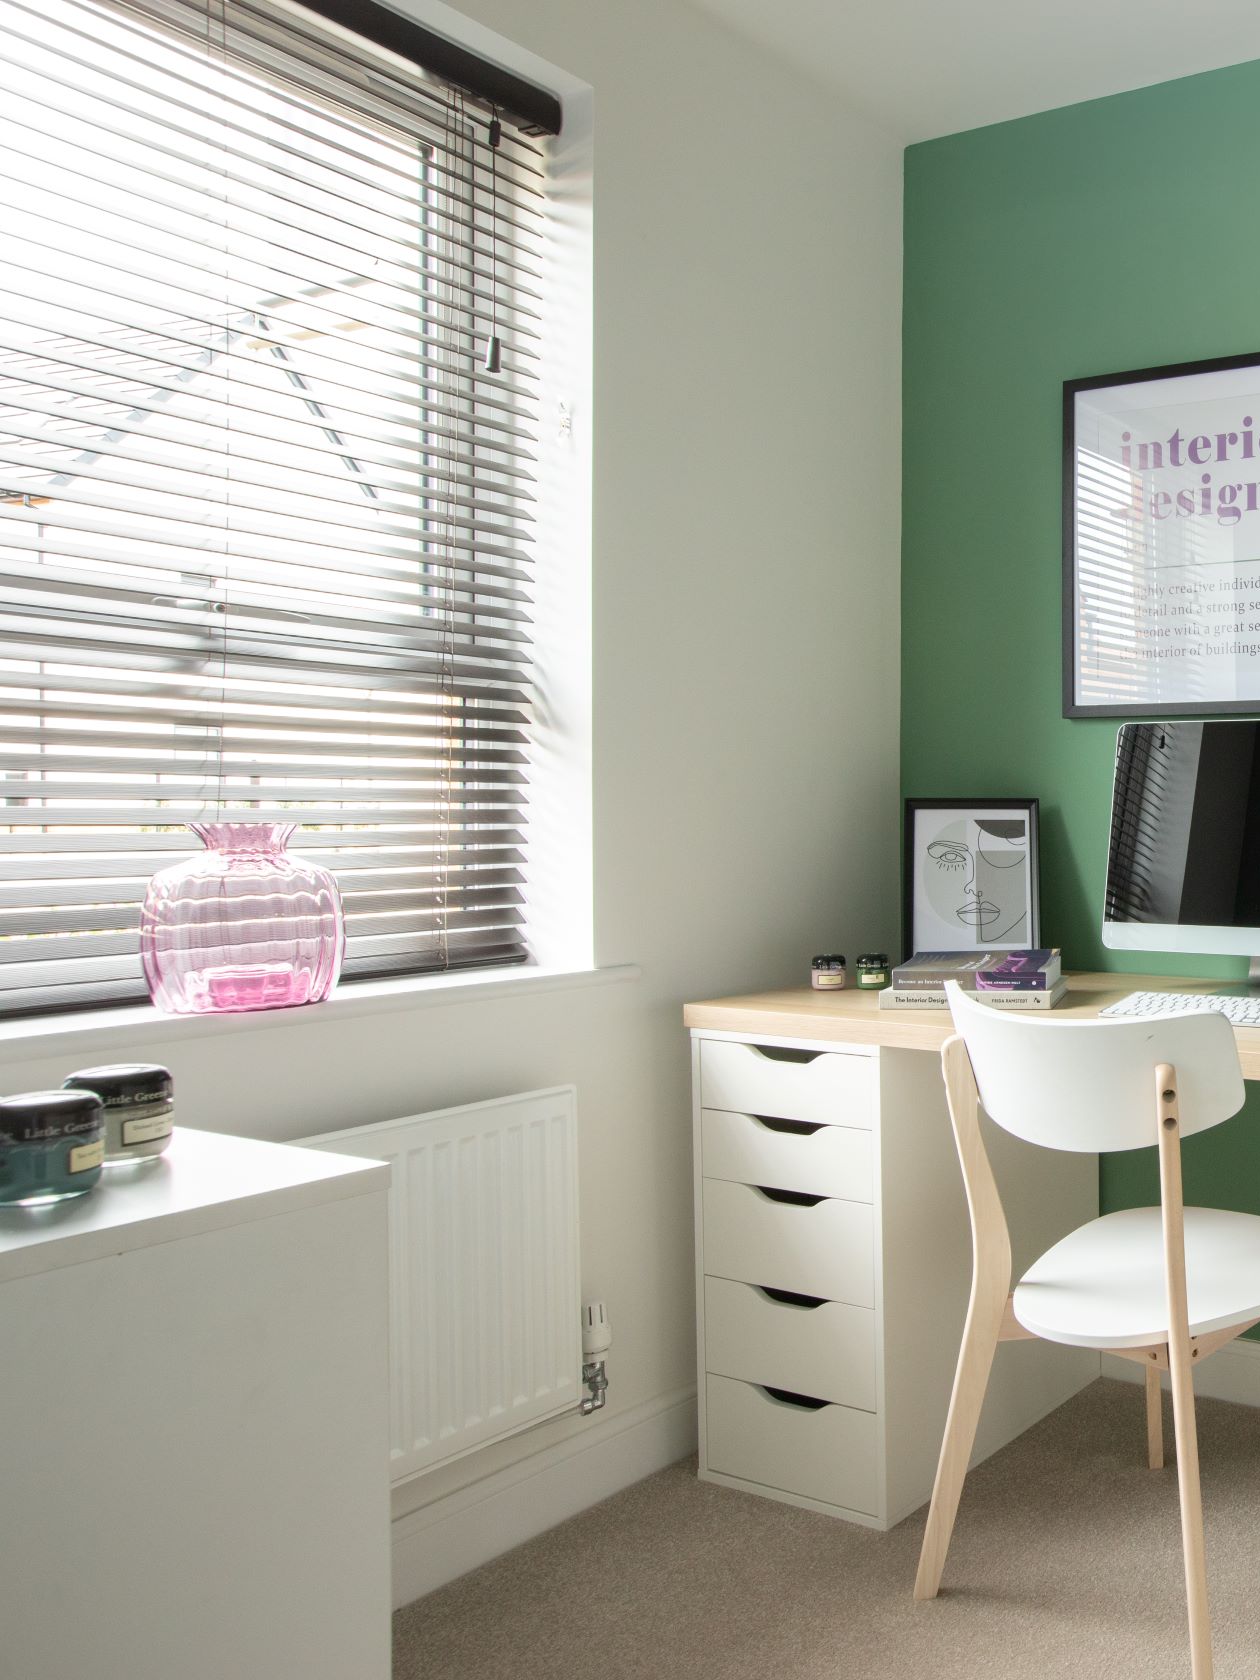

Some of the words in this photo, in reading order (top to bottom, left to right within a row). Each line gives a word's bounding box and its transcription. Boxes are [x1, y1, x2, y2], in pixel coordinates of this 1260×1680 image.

[1169, 581, 1215, 596] creative
[1170, 601, 1193, 617] and
[1206, 601, 1246, 615] strong
[1174, 622, 1200, 637] with
[1214, 621, 1245, 637] great
[1142, 645, 1187, 660] interior
[1189, 642, 1203, 657] of
[24, 1126, 62, 1139] Little
